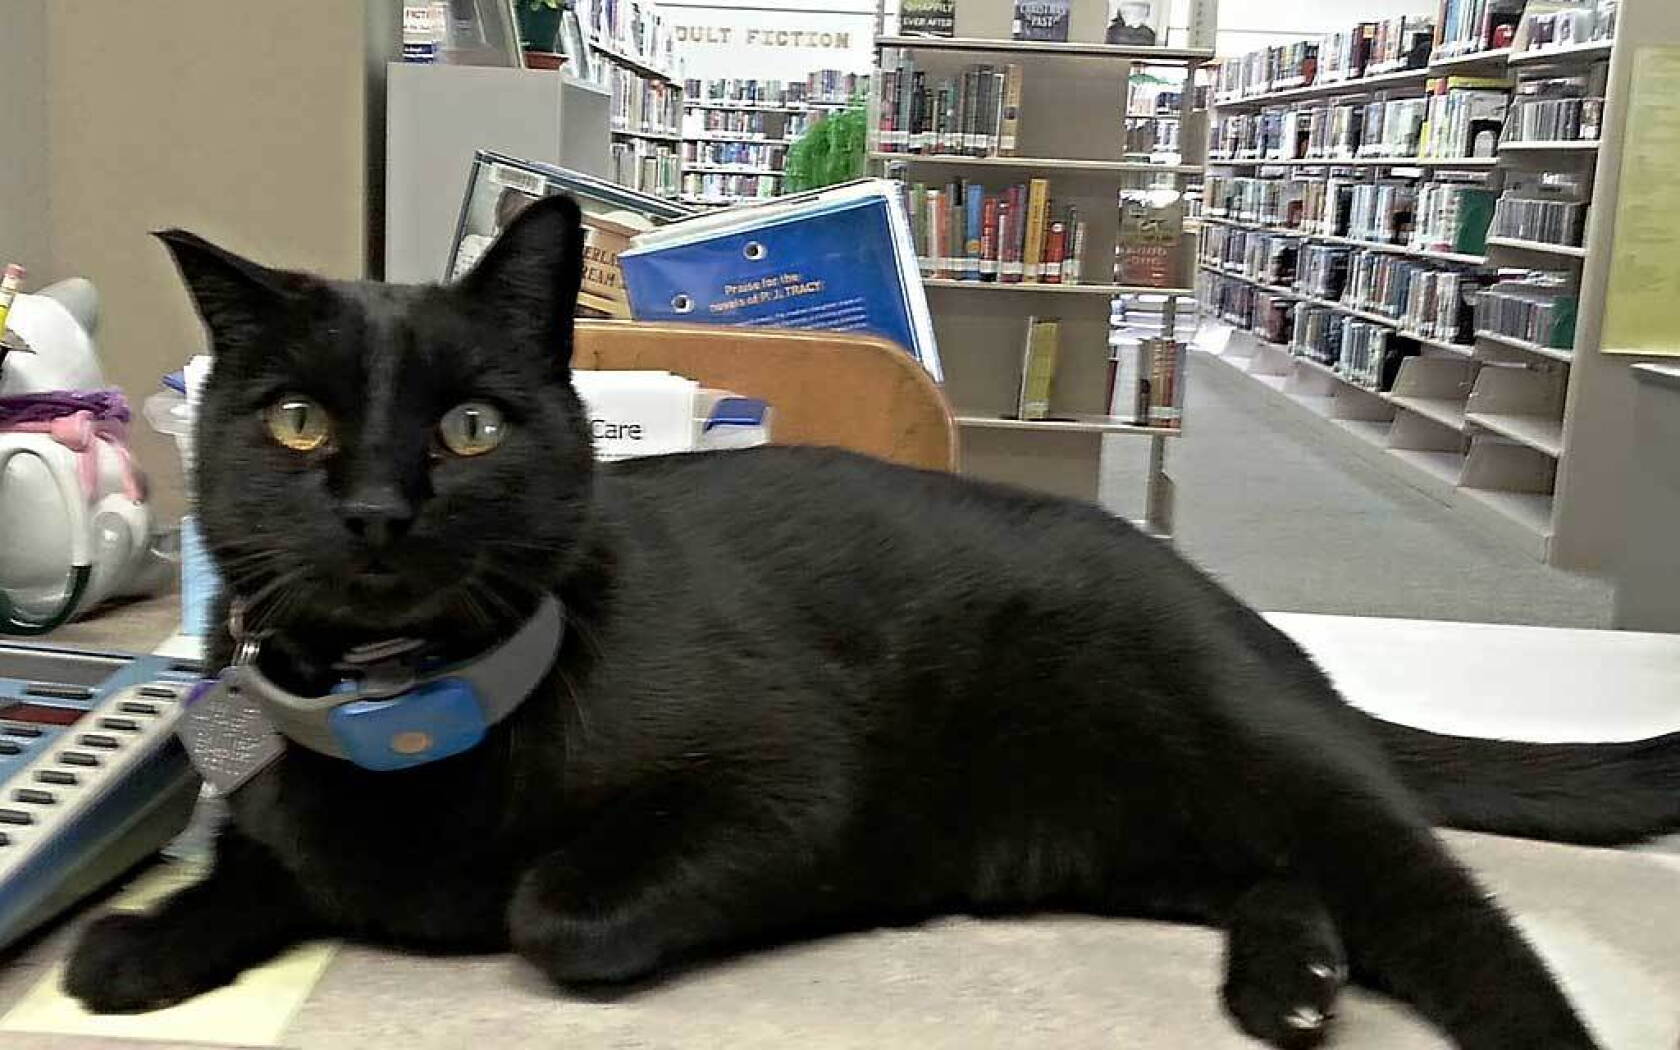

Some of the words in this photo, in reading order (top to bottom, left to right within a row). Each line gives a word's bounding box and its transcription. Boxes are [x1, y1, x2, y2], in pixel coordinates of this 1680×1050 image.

[747, 29, 849, 48] FICTION
[724, 281, 761, 296] Praise
[761, 276, 778, 289] for
[780, 272, 800, 285] the
[747, 294, 760, 306] of
[592, 419, 642, 440] Care
